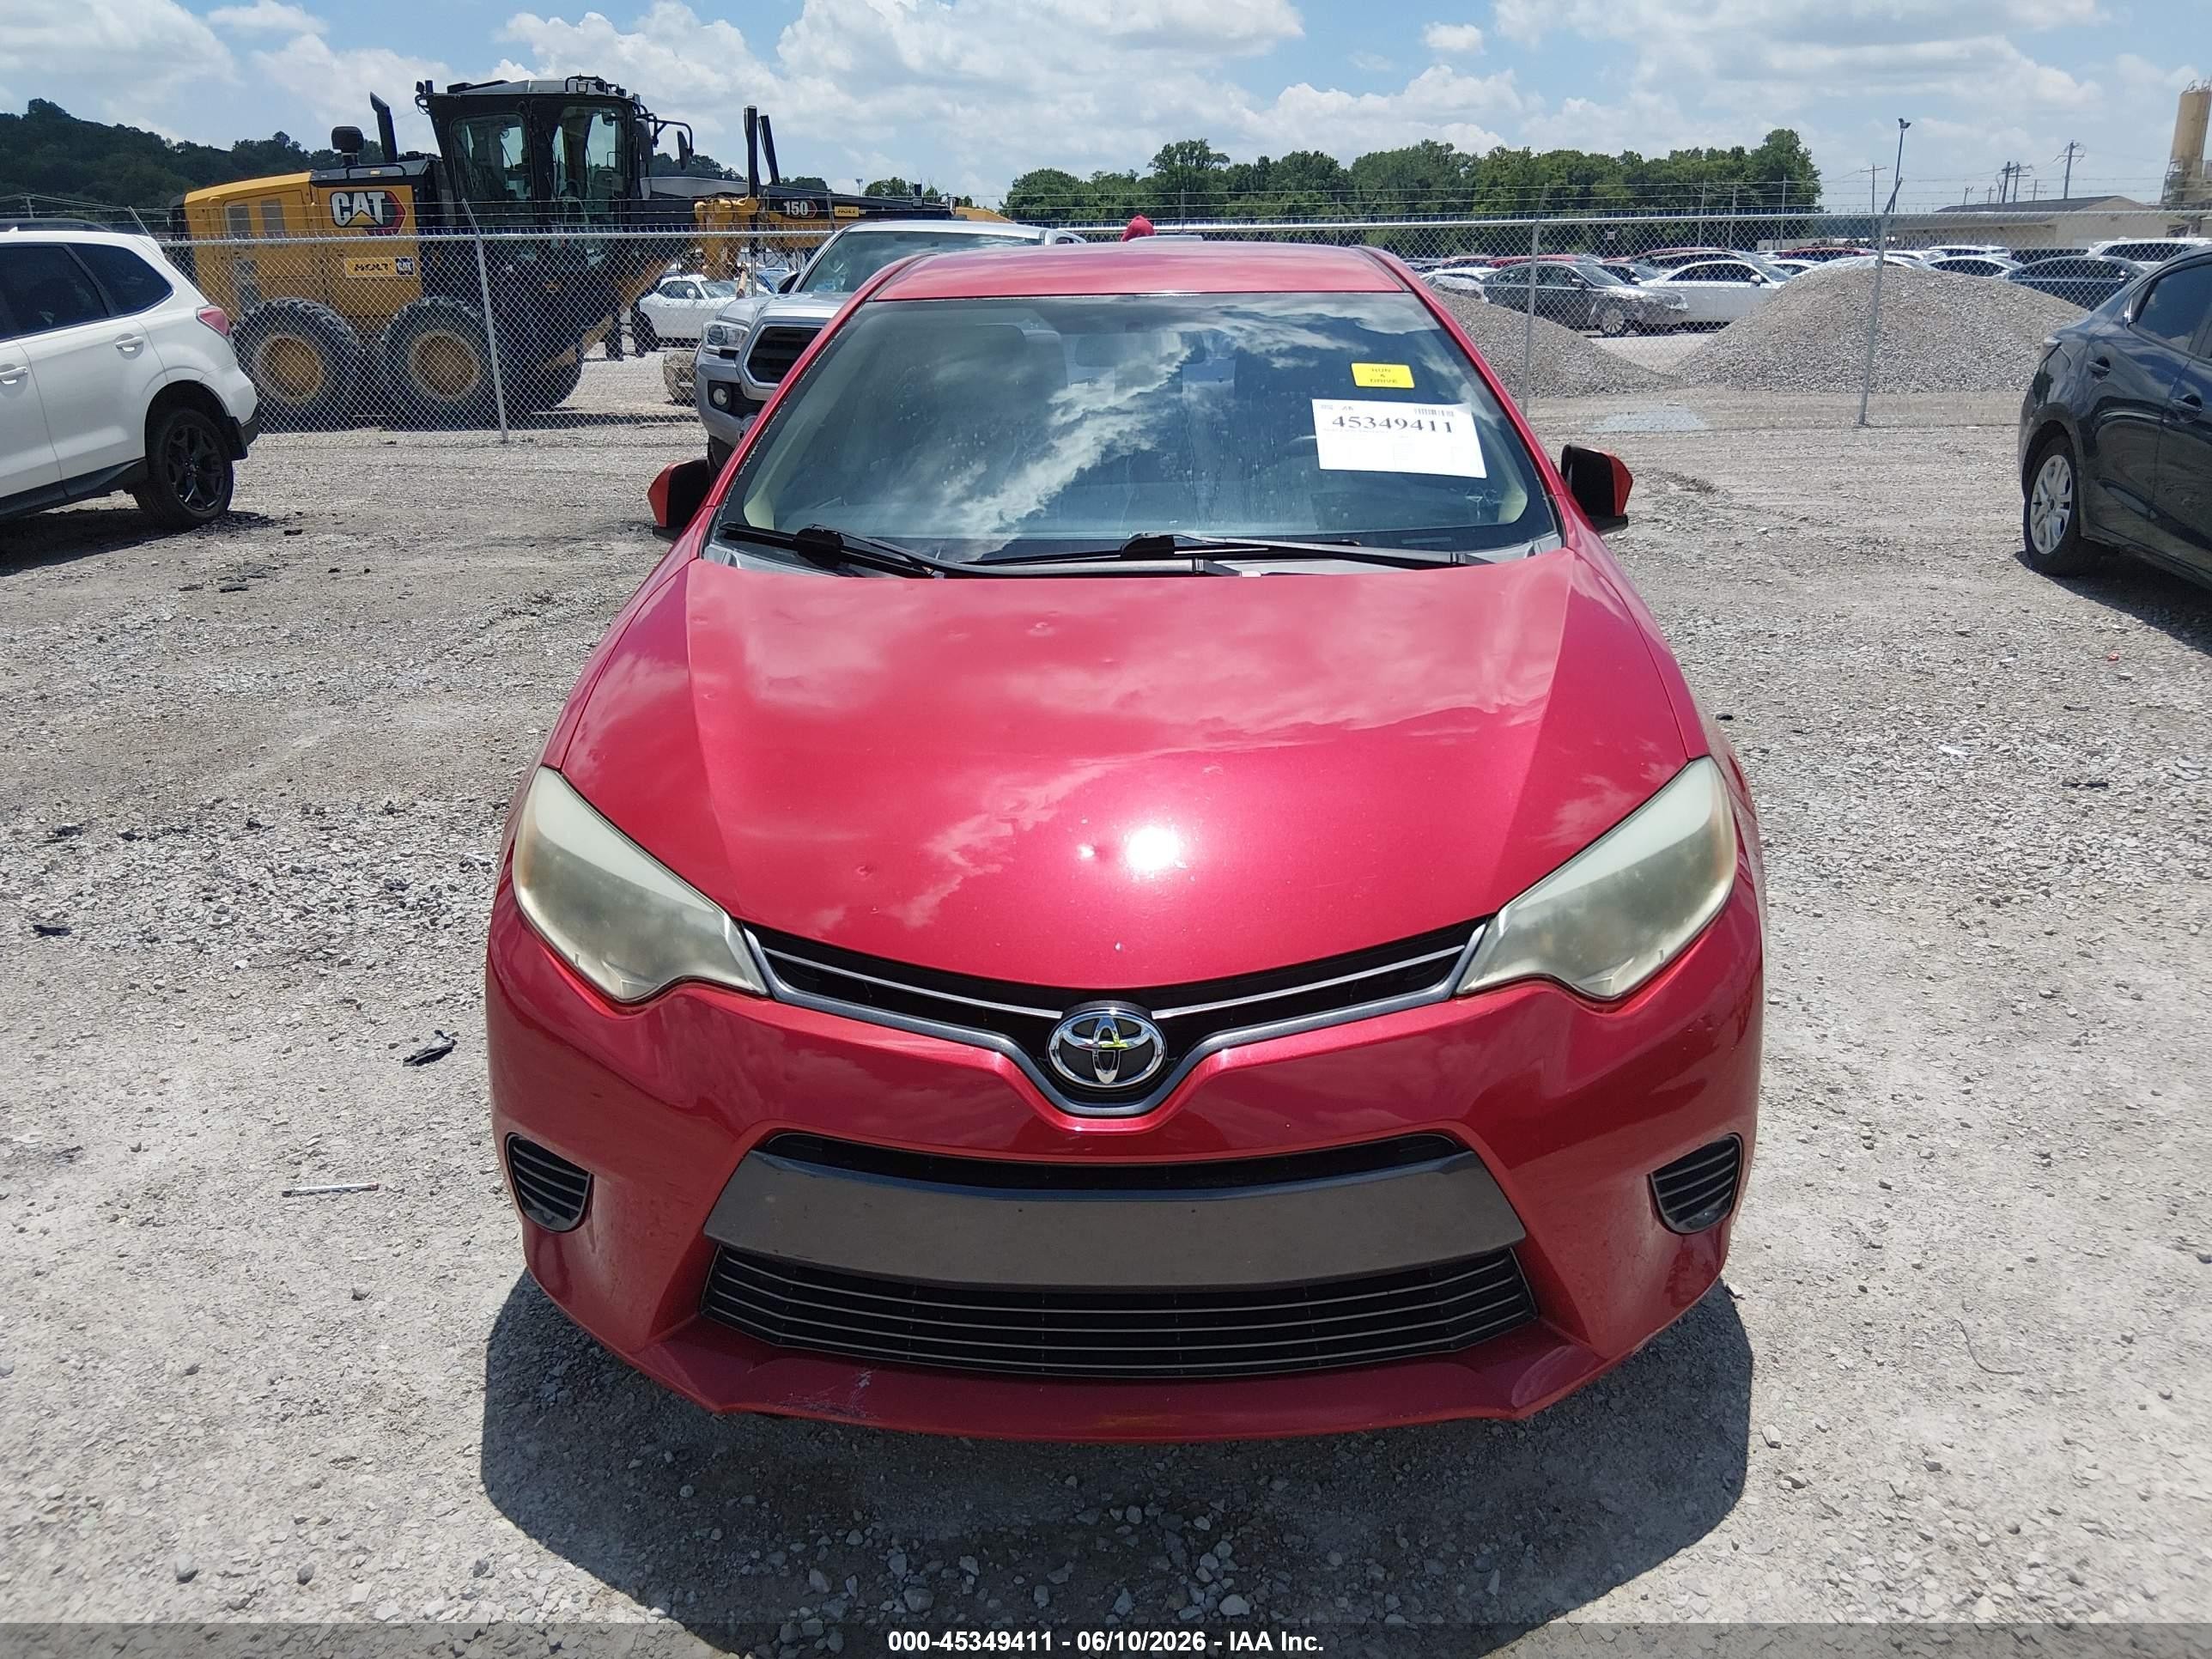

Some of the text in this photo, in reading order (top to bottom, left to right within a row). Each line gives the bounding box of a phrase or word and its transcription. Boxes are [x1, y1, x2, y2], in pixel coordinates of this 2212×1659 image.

[331, 191, 386, 227] CAT
[783, 201, 808, 216] 150
[1332, 416, 1453, 434] 45349411
